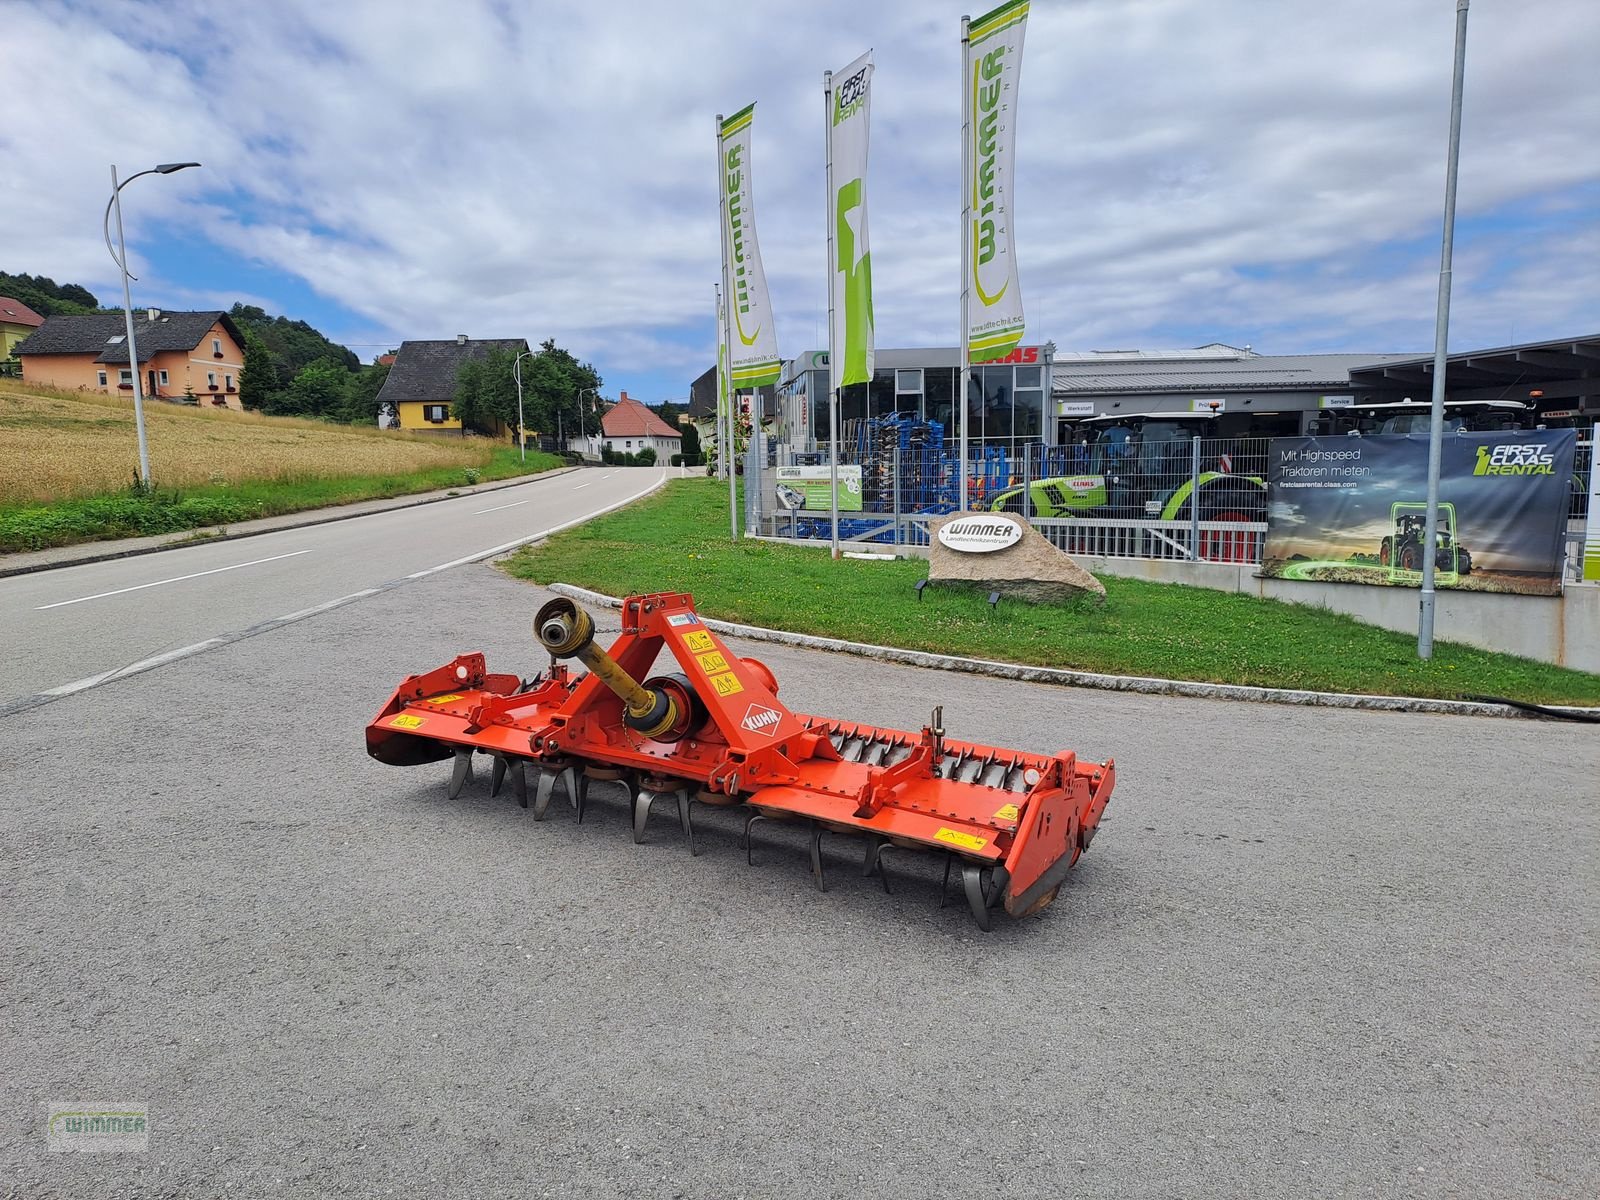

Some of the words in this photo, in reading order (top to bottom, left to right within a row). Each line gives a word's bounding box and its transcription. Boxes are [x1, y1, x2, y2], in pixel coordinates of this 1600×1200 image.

[979, 44, 1005, 265] WIMMER
[1281, 450, 1297, 461] Mit
[1300, 448, 1361, 463] Highspeed
[1492, 444, 1547, 456] FIRST
[1489, 454, 1554, 466] CLAAS
[1280, 465, 1328, 477] Traktoren
[1331, 465, 1373, 477] mieten.
[1486, 464, 1556, 475] RENTAL
[949, 523, 1014, 537] WIMMER
[745, 709, 778, 730] KUHN
